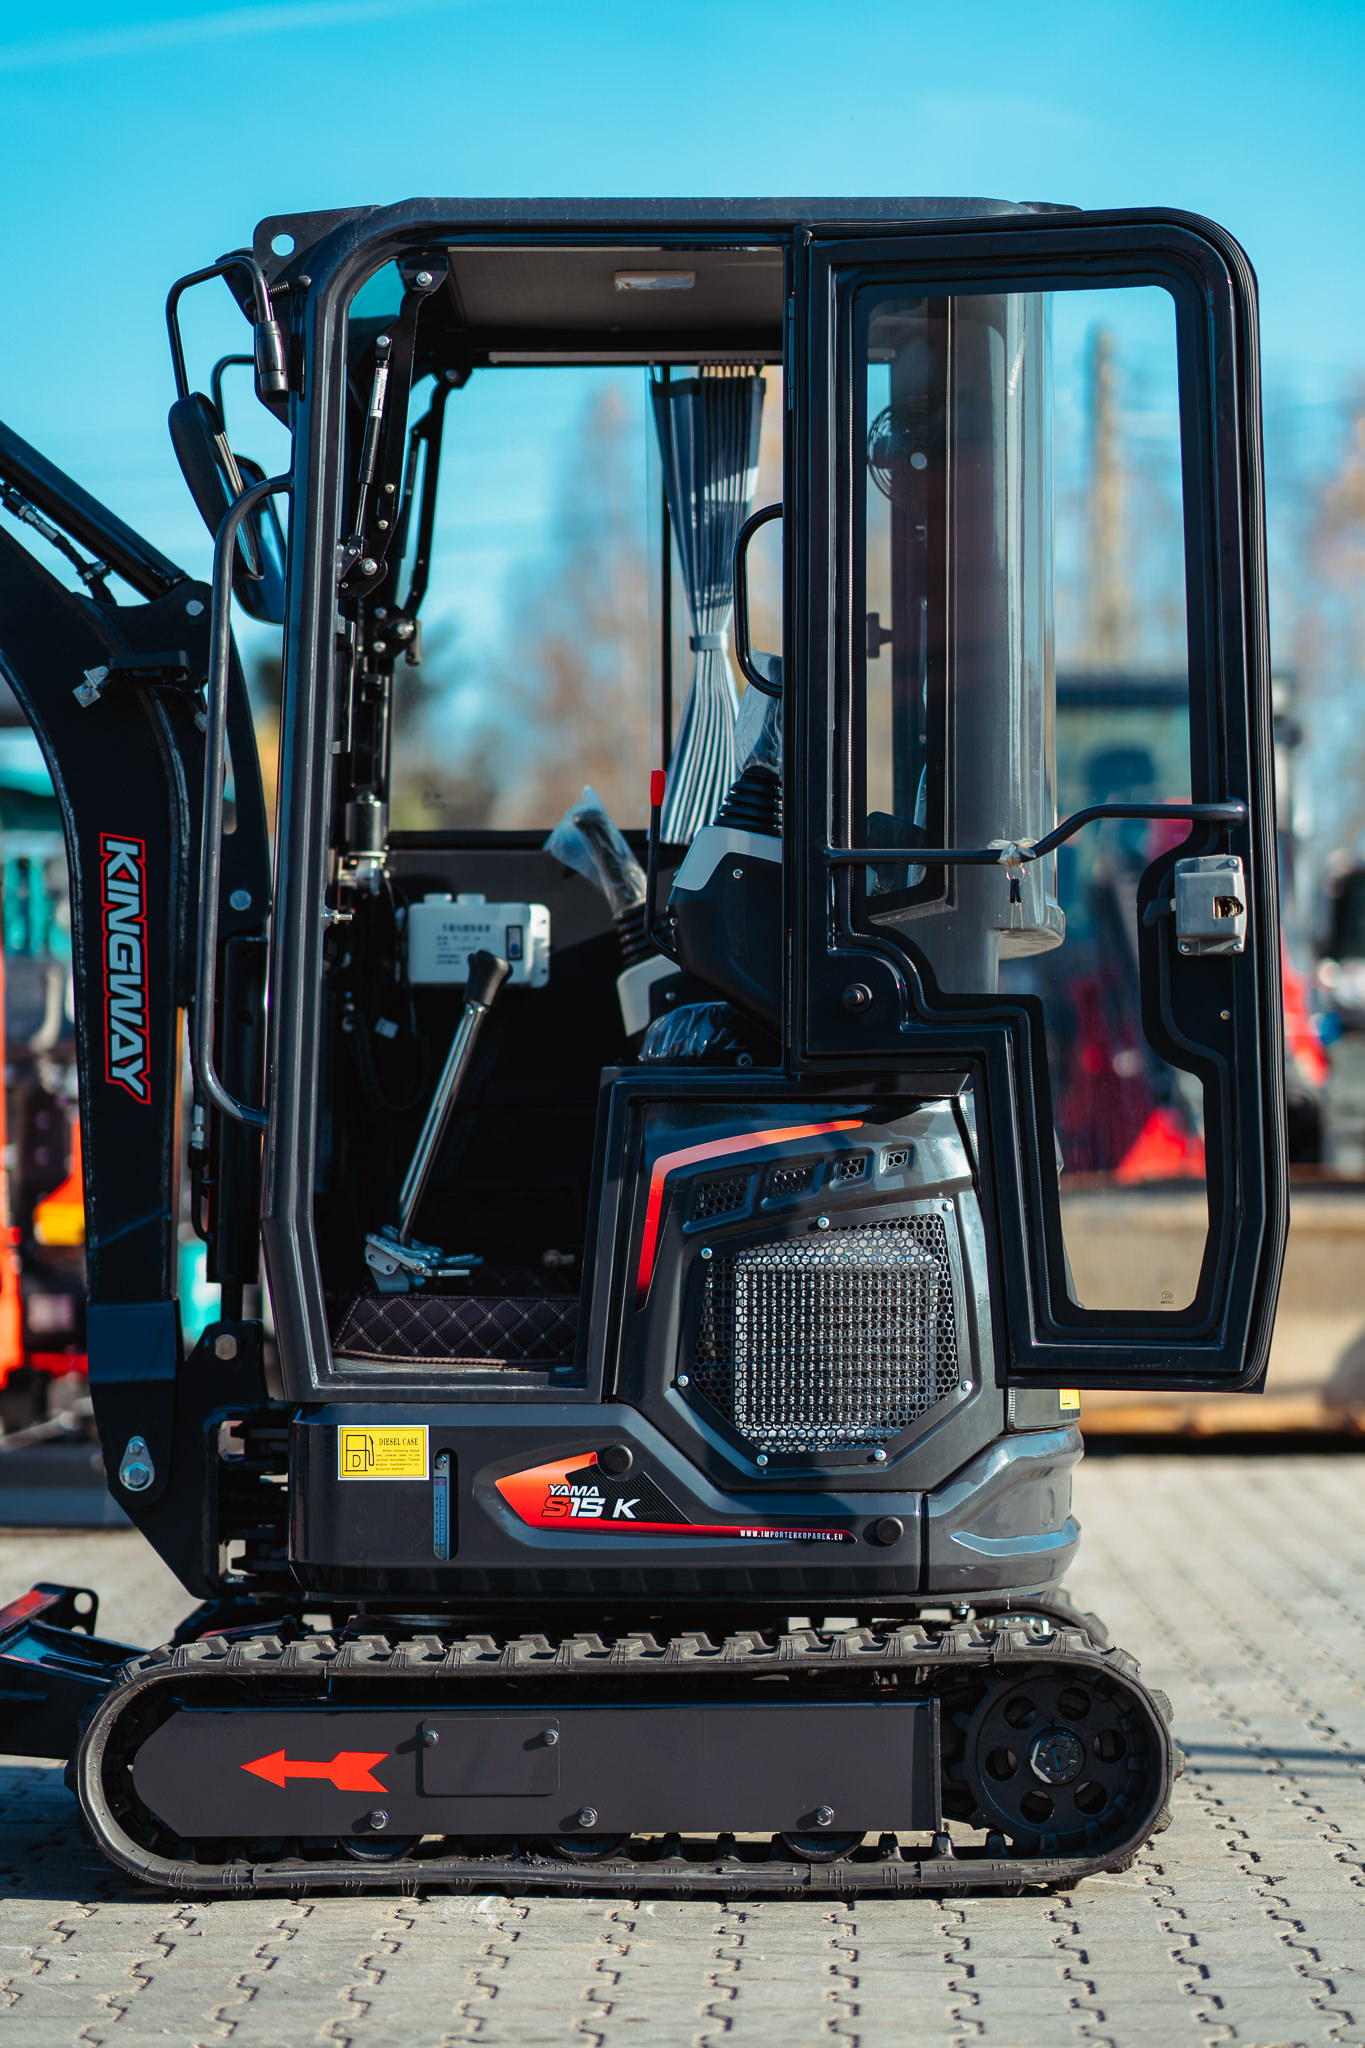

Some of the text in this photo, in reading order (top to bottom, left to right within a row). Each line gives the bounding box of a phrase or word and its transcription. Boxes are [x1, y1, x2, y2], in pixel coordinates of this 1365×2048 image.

[104, 836, 147, 1100] KINGWAY
[378, 1437, 419, 1446] DIESEL CASE
[352, 1454, 361, 1467] D
[548, 1484, 600, 1496] YAMA
[541, 1496, 641, 1518] S15 K
[740, 1529, 843, 1541] WWW.IMPORTERKOPAREK.EU
